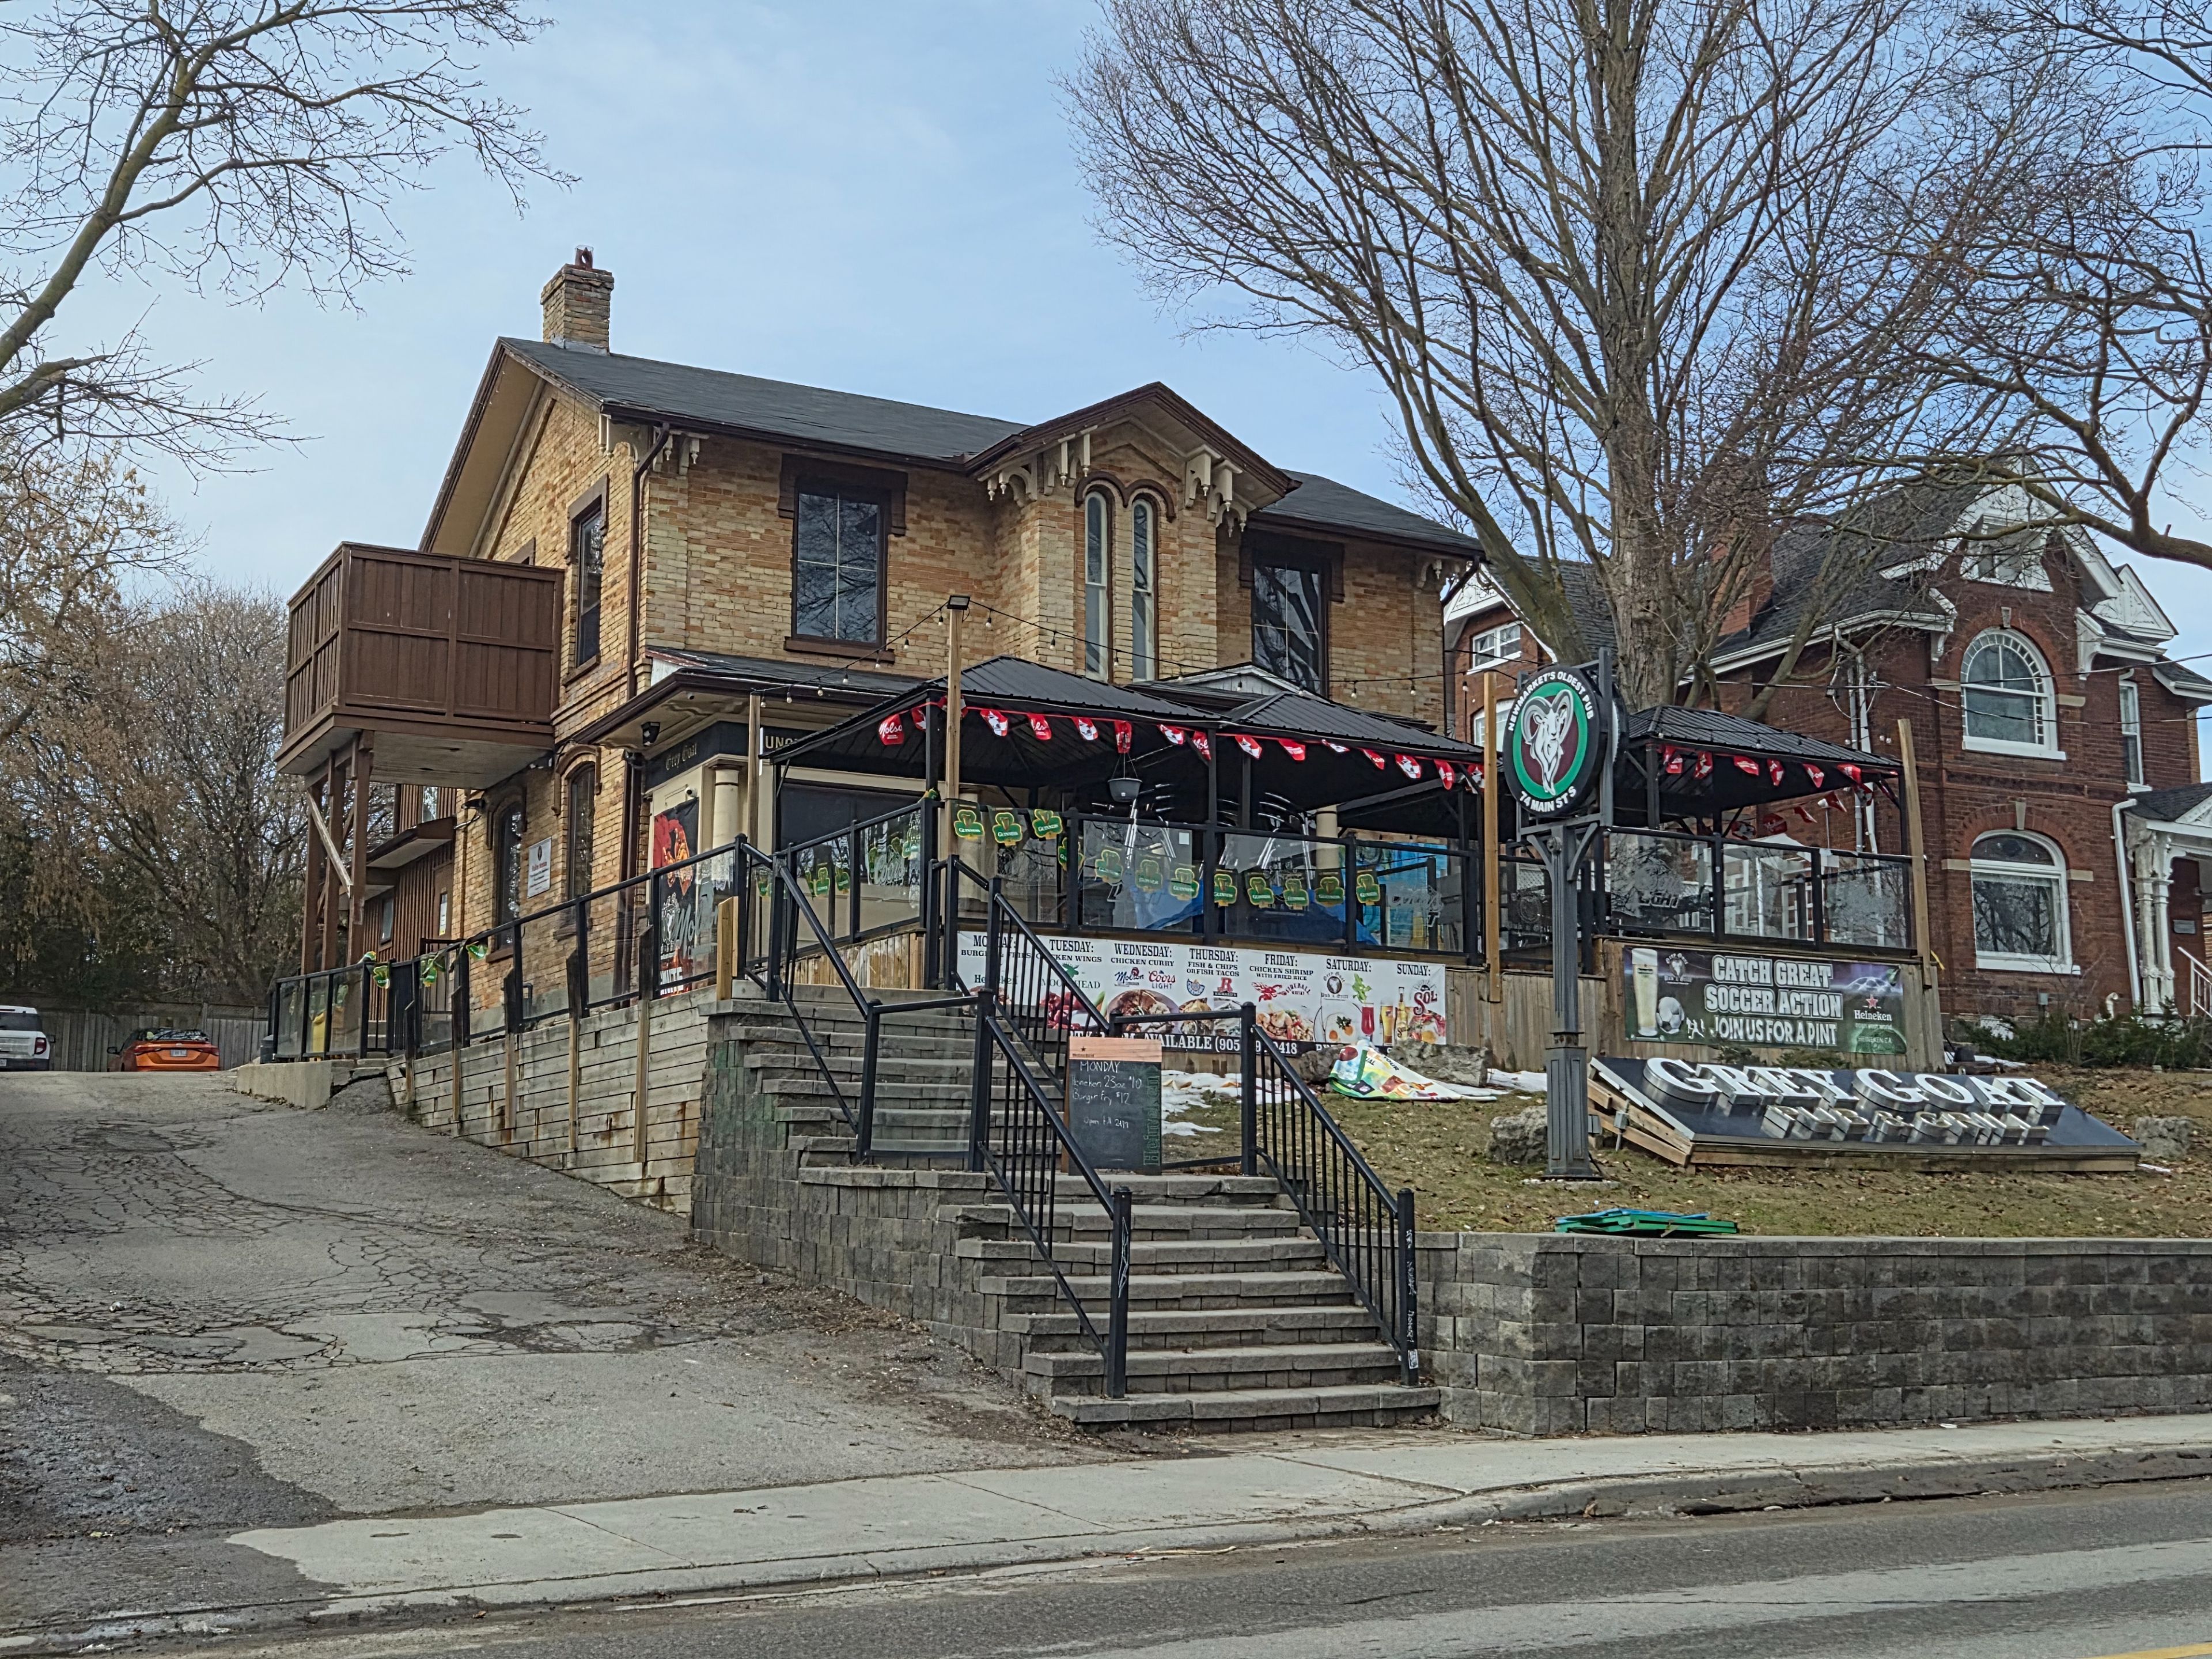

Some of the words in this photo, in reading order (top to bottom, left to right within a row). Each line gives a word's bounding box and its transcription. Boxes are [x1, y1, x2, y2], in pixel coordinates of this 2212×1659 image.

[1508, 672, 1556, 731] NEWMARKET'S
[1557, 671, 1586, 695] OLDEST
[1582, 695, 1594, 719] PUB
[1520, 790, 1532, 806] 74
[1530, 800, 1554, 812] MAIN
[1556, 793, 1568, 808] ST
[1568, 786, 1576, 797] S
[974, 935, 1016, 948] MOAY:
[1049, 939, 1094, 953] TUESDAY:
[1115, 943, 1172, 957] WEDNESDAY:
[1189, 948, 1238, 962] THURSDAY:
[1265, 954, 1297, 967] FRIDAY:
[1326, 959, 1372, 972] SATURDAY:
[1149, 970, 1175, 983] Coors
[1397, 963, 1430, 976] SUNDAY:
[1712, 955, 1773, 986] CATCH
[1774, 960, 1834, 990] GREAT
[1704, 984, 1777, 1016] SOCCER
[1777, 989, 1843, 1020] ACTION
[1854, 1010, 1892, 1021] Heineken
[1710, 1016, 1744, 1041] JOIN
[1745, 1017, 1764, 1043] US
[1765, 1018, 1794, 1043] FOR
[1796, 1020, 1806, 1044] A
[1808, 1021, 1837, 1046] PINT
[1215, 1036, 1240, 1052] (905
[1080, 1060, 1120, 1073] MONDAY
[1644, 1057, 1859, 1103] GREY
[1853, 1069, 2066, 1107] GOAT
